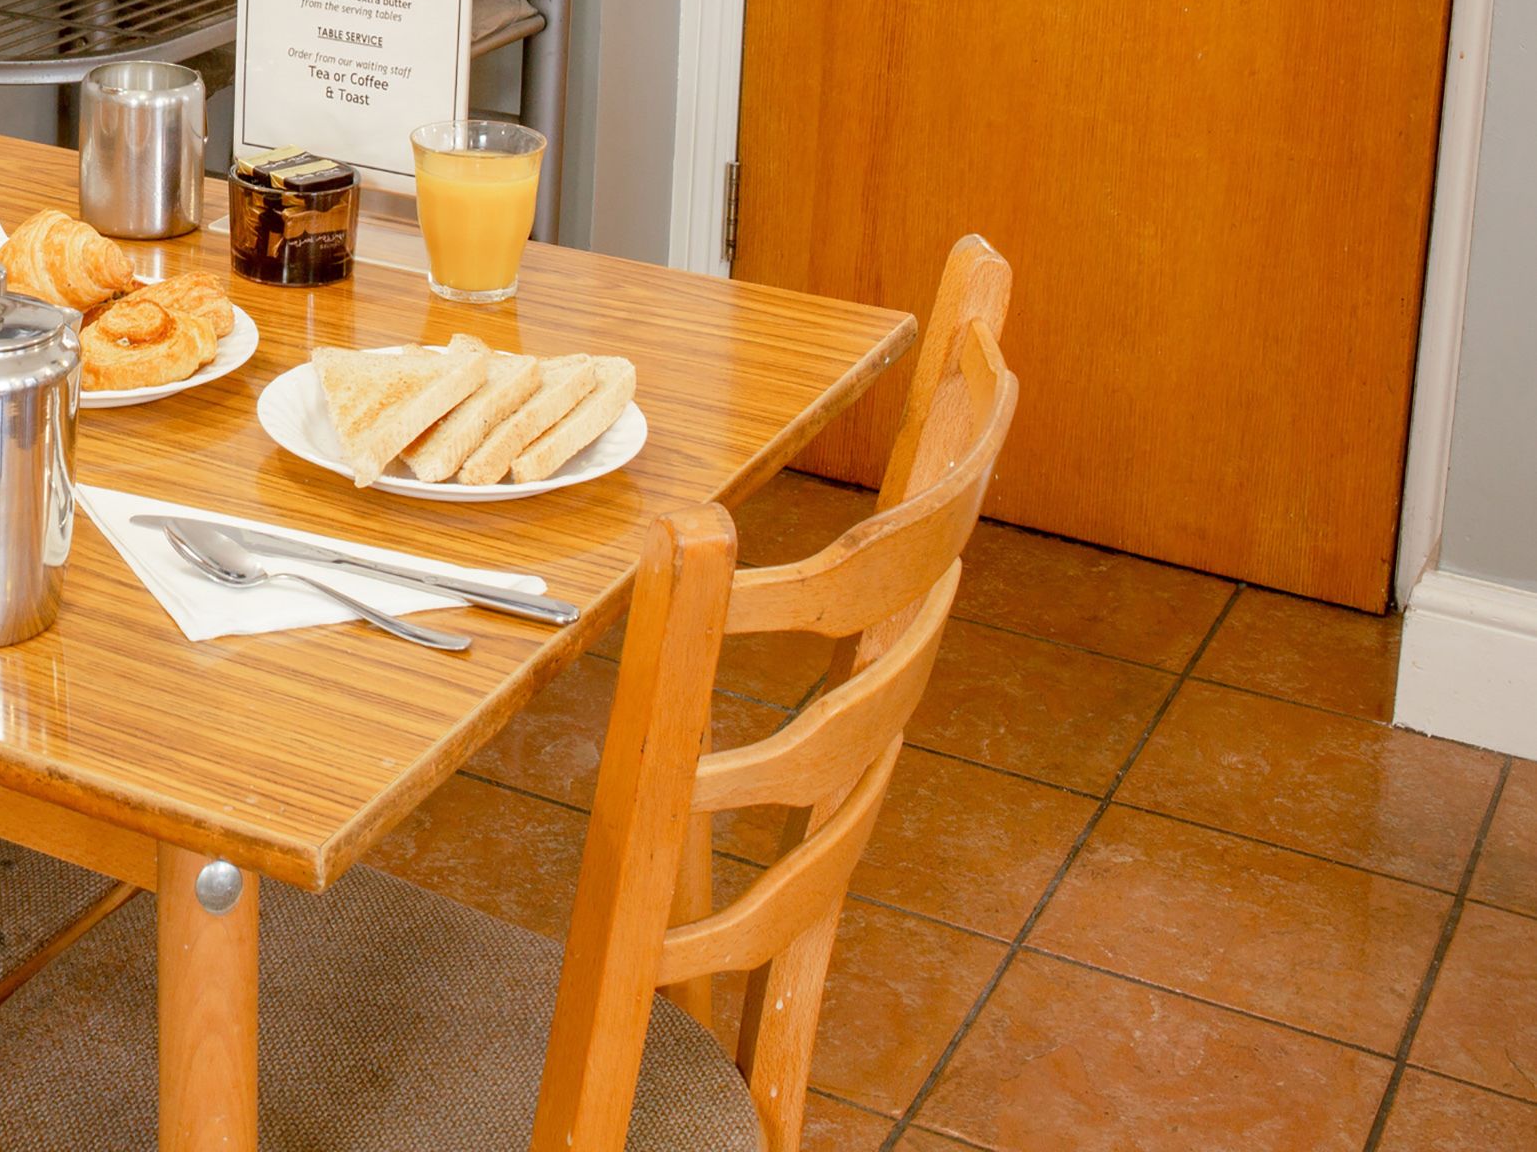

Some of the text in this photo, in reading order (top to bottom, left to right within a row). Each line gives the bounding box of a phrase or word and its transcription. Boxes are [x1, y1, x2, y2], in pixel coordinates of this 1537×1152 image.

[325, 1, 339, 12] the
[342, 5, 372, 19] serving
[375, 9, 402, 21] tables
[318, 27, 383, 46] TABLE SERVICE
[288, 48, 412, 79] Order from our waiting staff
[309, 66, 389, 90] Tea or Coffee
[326, 87, 370, 105] & Toast
